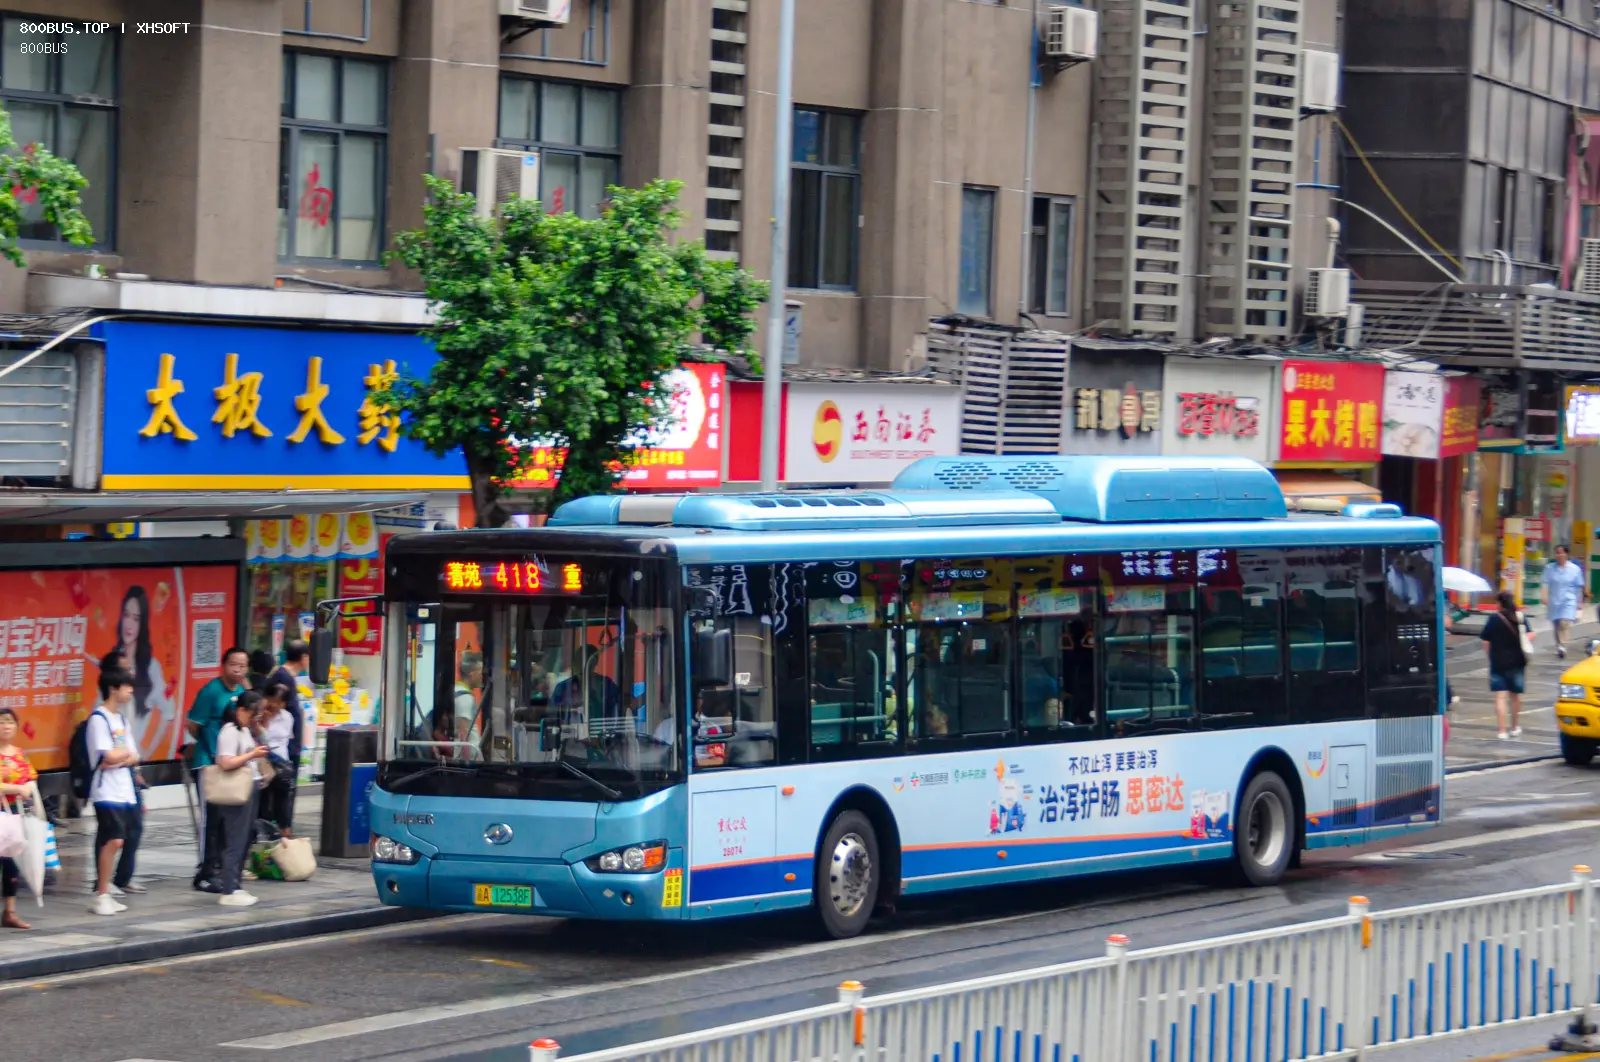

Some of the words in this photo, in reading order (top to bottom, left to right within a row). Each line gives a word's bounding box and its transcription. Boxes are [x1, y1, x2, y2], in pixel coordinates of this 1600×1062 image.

[851, 405, 937, 444] 西南证券
[1285, 398, 1378, 448] 果木烤鸭
[447, 562, 482, 588] 菁苑
[496, 562, 540, 589] 418
[563, 563, 582, 589] 重
[1039, 780, 1121, 824] 治泻护肠
[1126, 773, 1185, 815] 思密达
